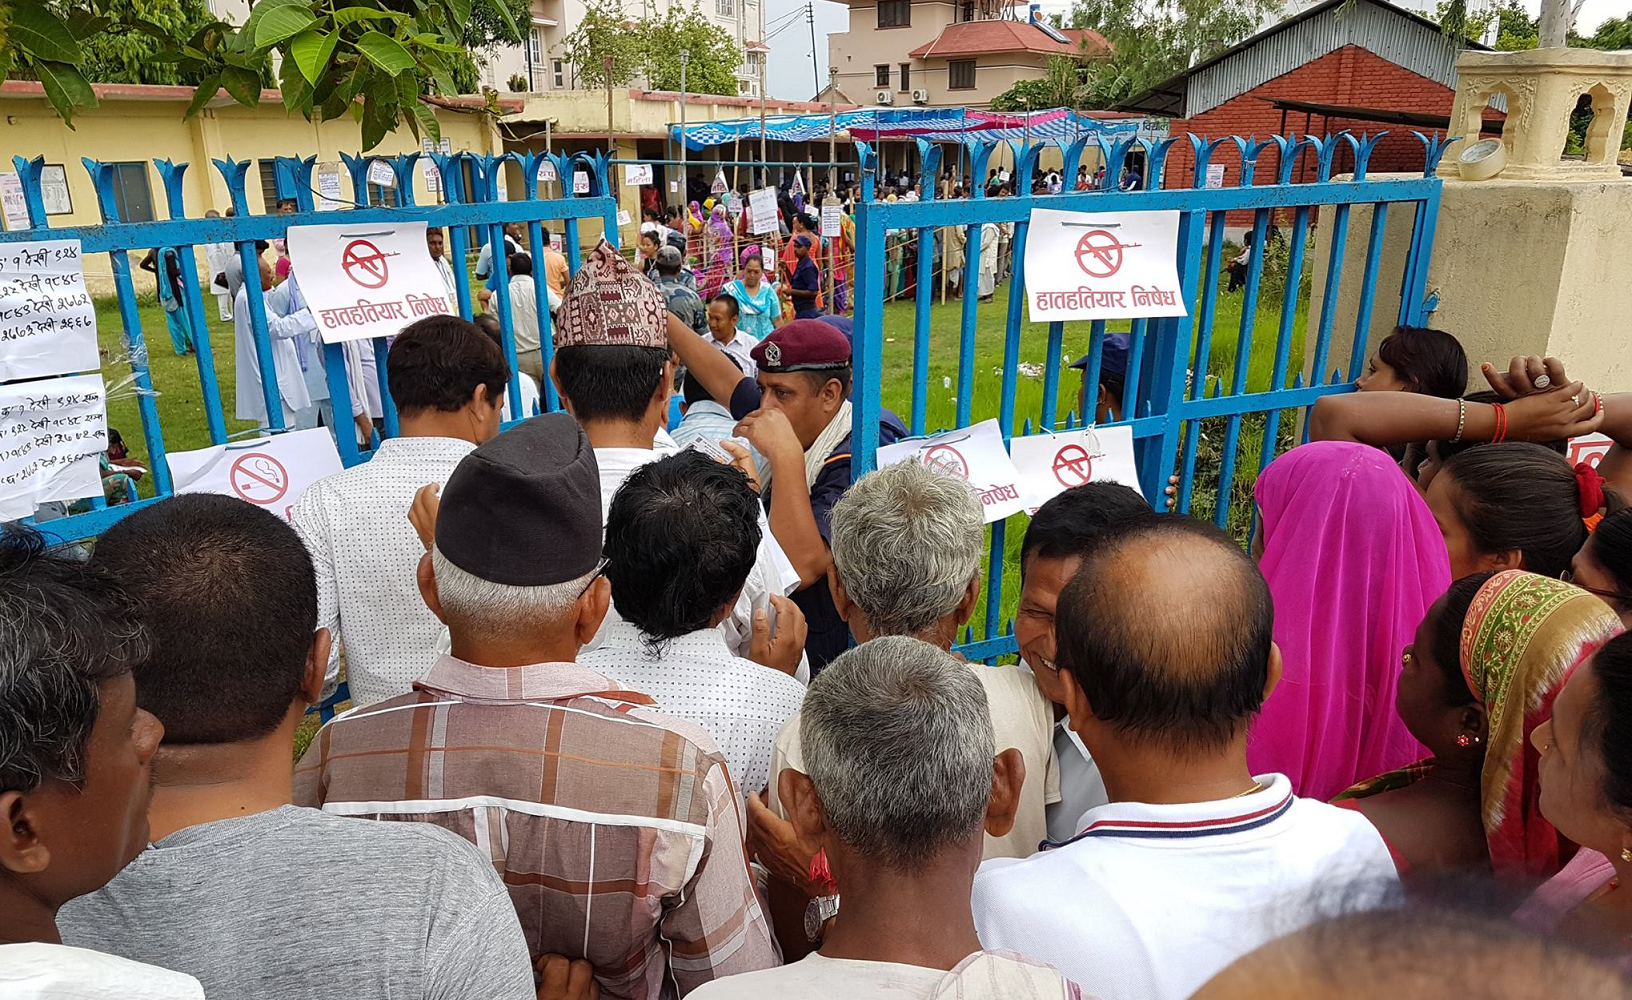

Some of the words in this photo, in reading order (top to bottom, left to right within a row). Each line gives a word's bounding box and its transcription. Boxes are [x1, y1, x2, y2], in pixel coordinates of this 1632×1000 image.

[318, 298, 408, 329] हातहतियार
[405, 292, 450, 317] निषेध
[1035, 285, 1128, 311] हातहतियार
[1130, 285, 1177, 308] निषेध
